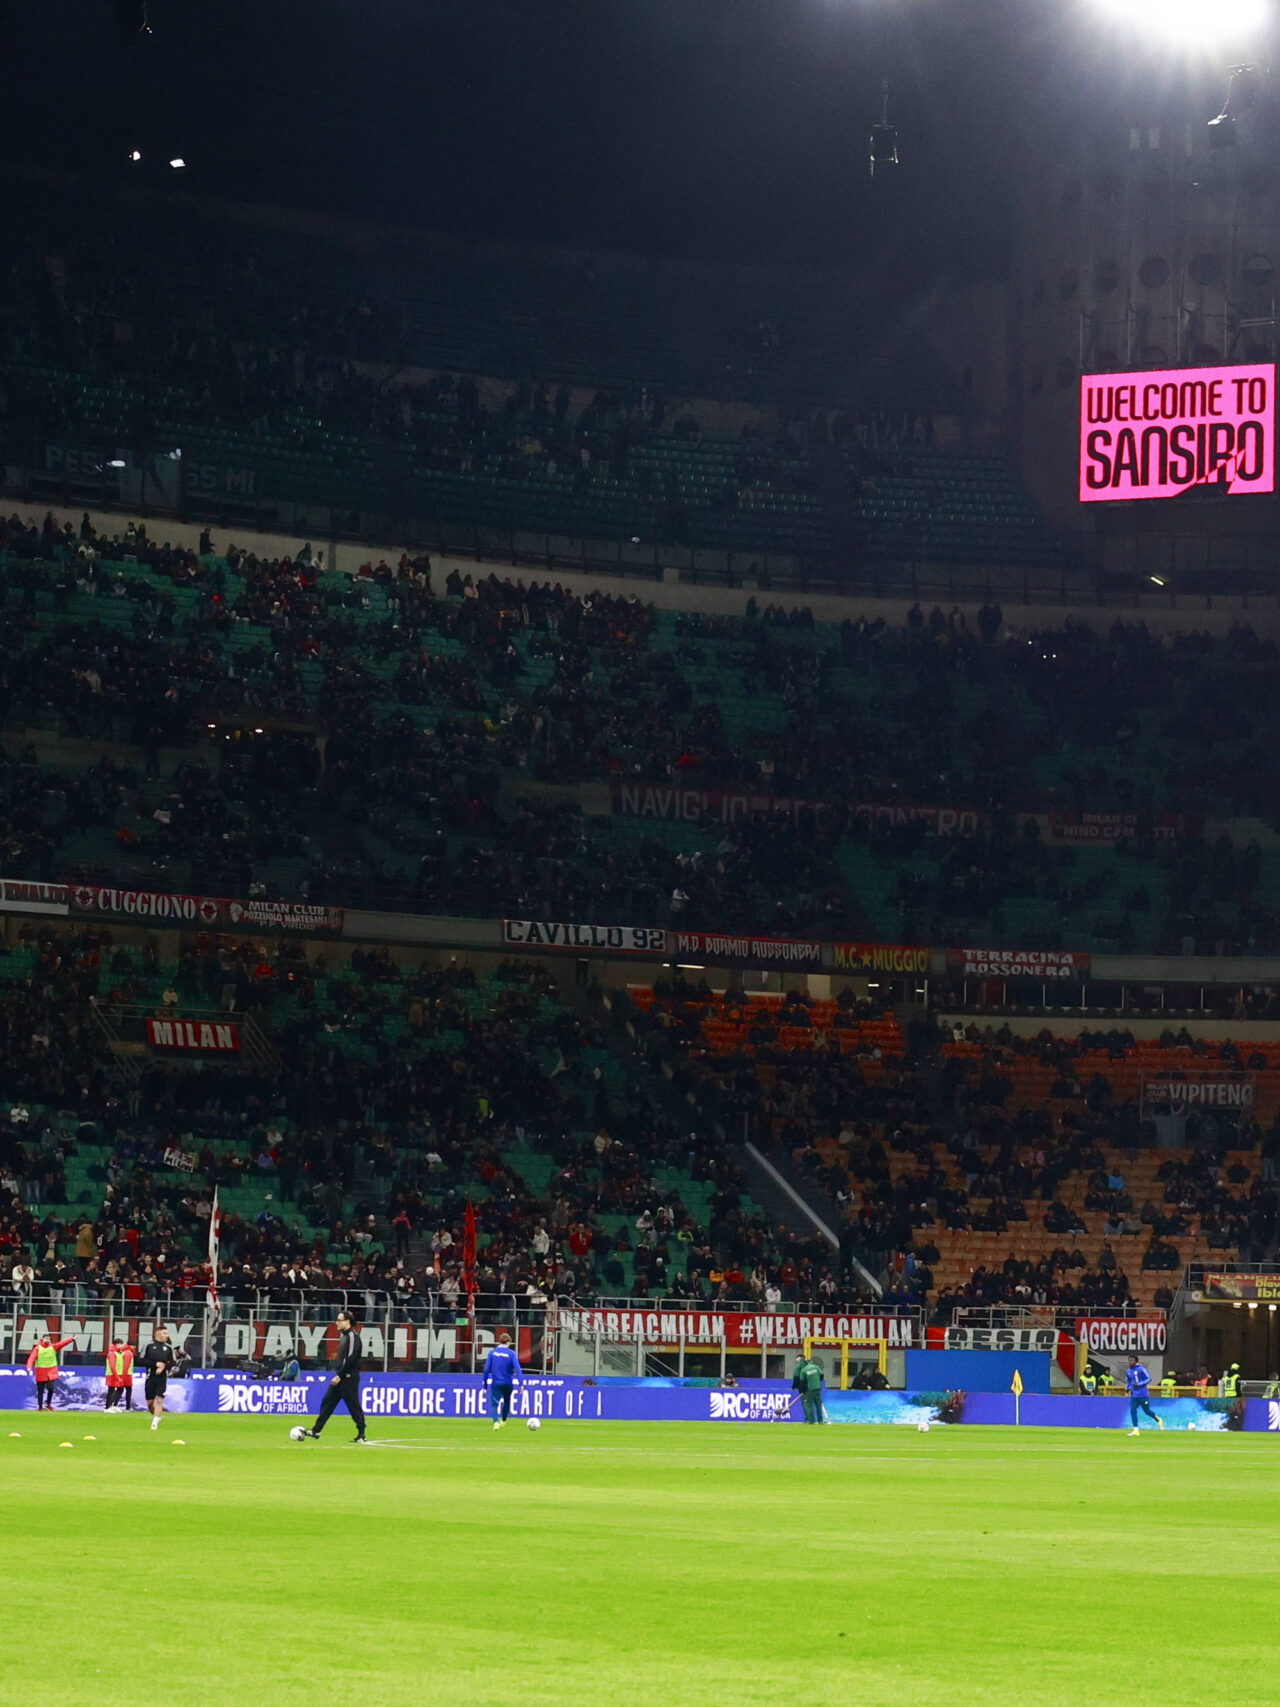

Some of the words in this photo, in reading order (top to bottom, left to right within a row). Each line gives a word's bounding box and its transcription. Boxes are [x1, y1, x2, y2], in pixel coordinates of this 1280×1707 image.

[1087, 380, 1223, 423] WELCOME
[1231, 377, 1266, 414] TO
[1086, 421, 1264, 489] SANSIRO
[97, 889, 196, 920] CUGGIONO
[248, 901, 290, 914] MILAN
[294, 904, 325, 916] CLUB
[506, 921, 623, 948] CAVILLO
[632, 927, 664, 950] 92
[872, 950, 929, 972] MUGGIO
[963, 949, 1074, 963] TERRACINA
[965, 962, 1071, 976] ROSSONERA
[152, 1021, 233, 1048] MILAN
[225, 1323, 328, 1357] DAY
[739, 1317, 912, 1347] #WEAREACMILAN
[1080, 1321, 1166, 1351] AGRIGENTO
[263, 1386, 309, 1403] HEART
[263, 1403, 275, 1412] OF
[277, 1403, 309, 1413] AFRICA
[361, 1387, 445, 1414] EXPLORE
[453, 1388, 487, 1414] THE
[565, 1390, 584, 1416] OF
[750, 1394, 791, 1410] HEART
[750, 1410, 760, 1419] OF
